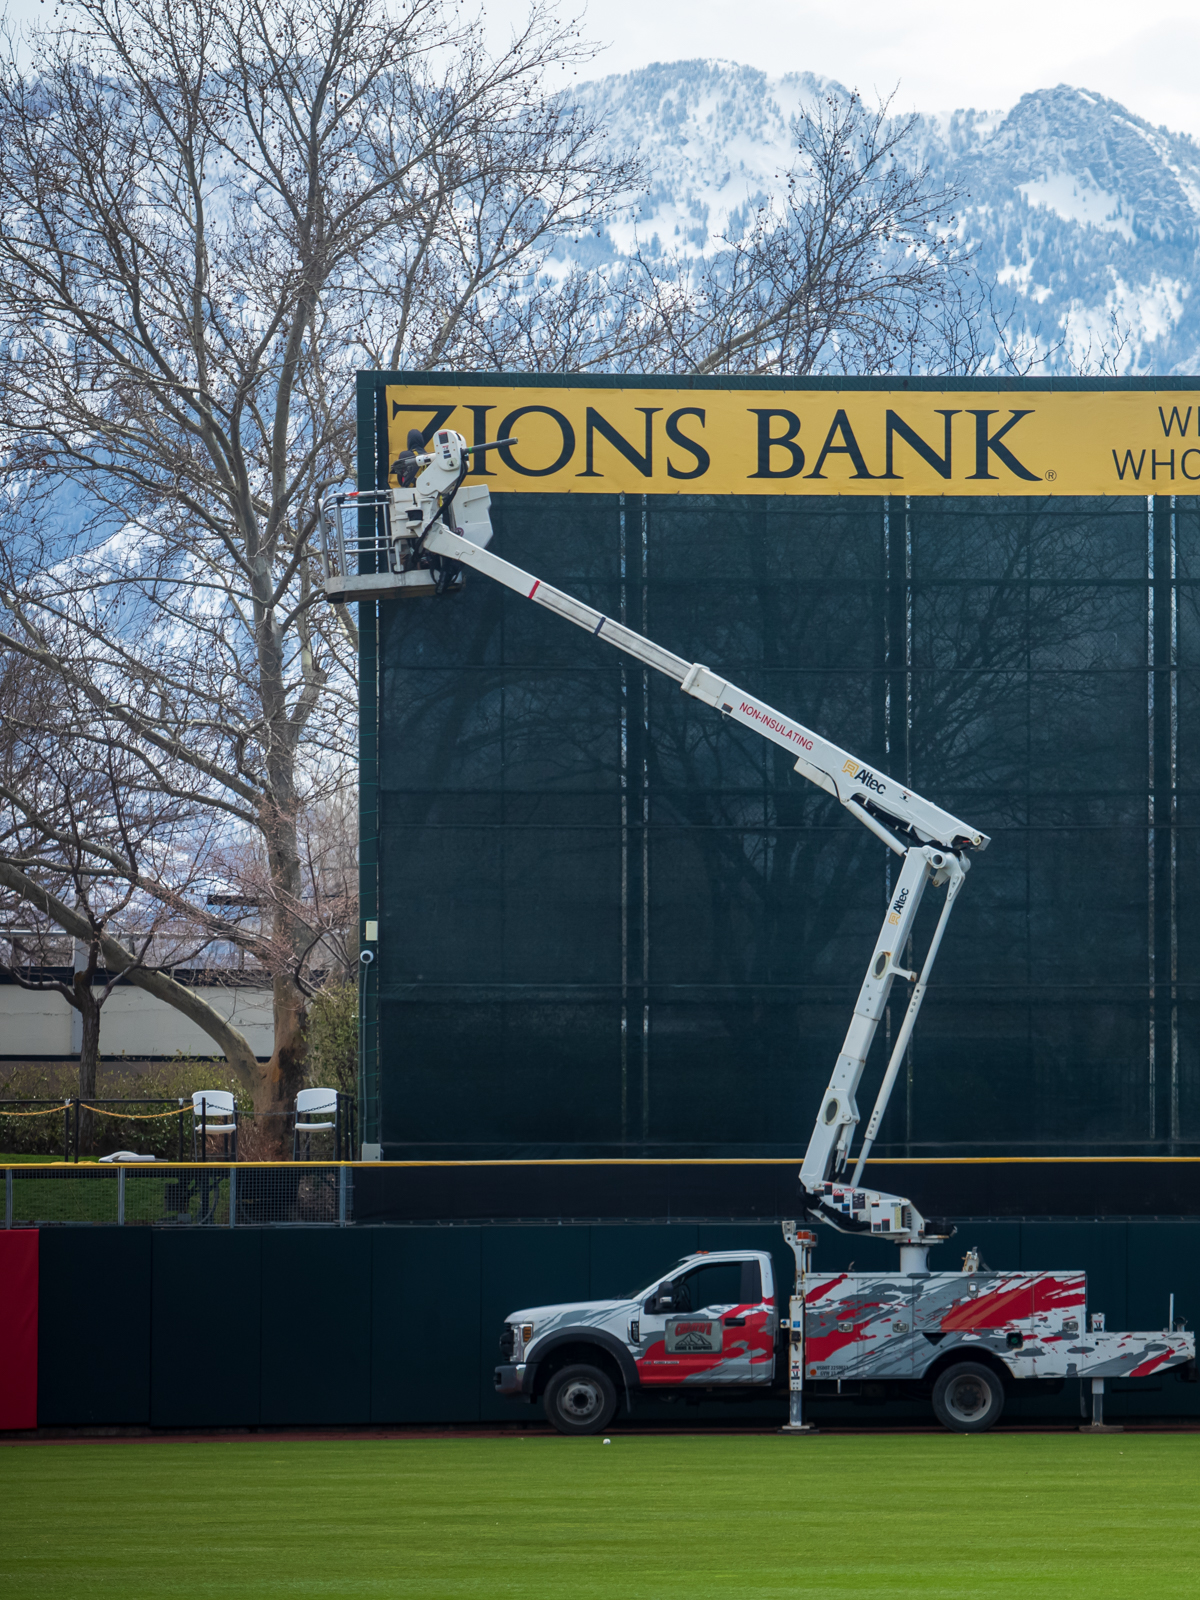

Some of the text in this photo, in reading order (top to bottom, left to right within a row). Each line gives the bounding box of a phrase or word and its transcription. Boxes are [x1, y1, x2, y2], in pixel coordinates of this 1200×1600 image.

[391, 400, 711, 480] ZIONS
[739, 702, 814, 751] NON-INSULATING
[854, 769, 886, 795] Altec
[893, 888, 909, 915] Altec
